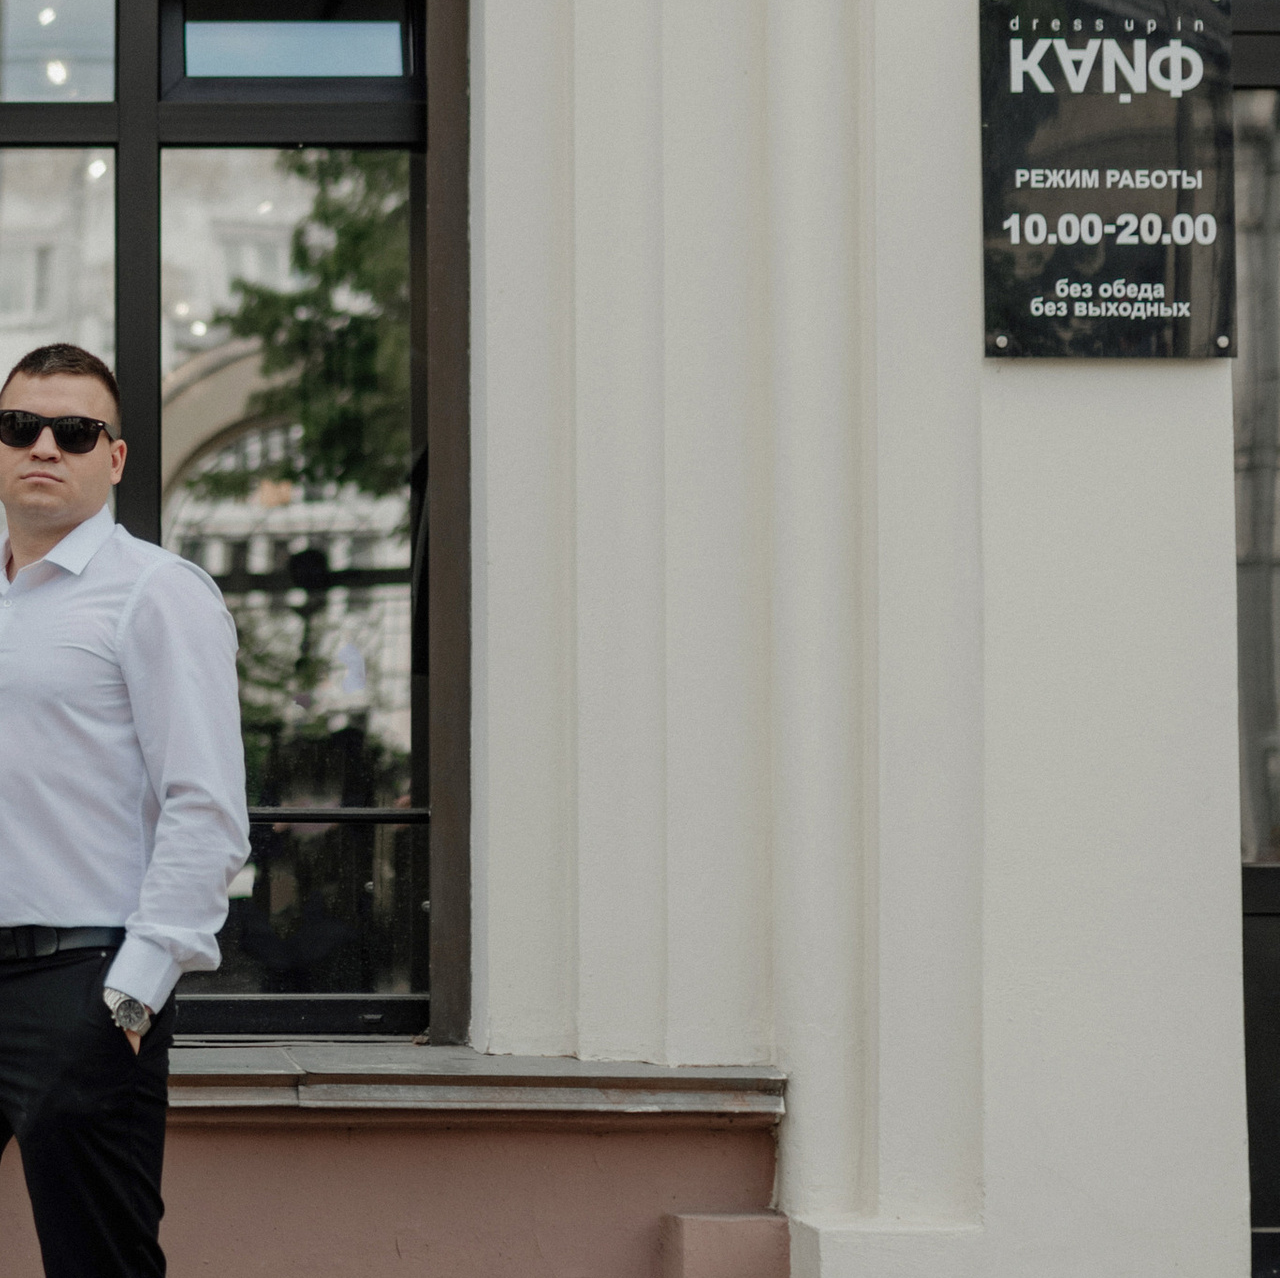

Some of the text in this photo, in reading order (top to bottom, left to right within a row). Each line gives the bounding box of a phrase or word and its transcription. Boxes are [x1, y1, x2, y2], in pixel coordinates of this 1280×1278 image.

[1009, 15, 1204, 35] dress up in
[1015, 168, 1203, 190] РЕЖИМ РАБОТЫ
[1003, 213, 1217, 245] 10.00-20.00
[1055, 278, 1165, 300] без обеда
[1030, 297, 1191, 320] без выходных
